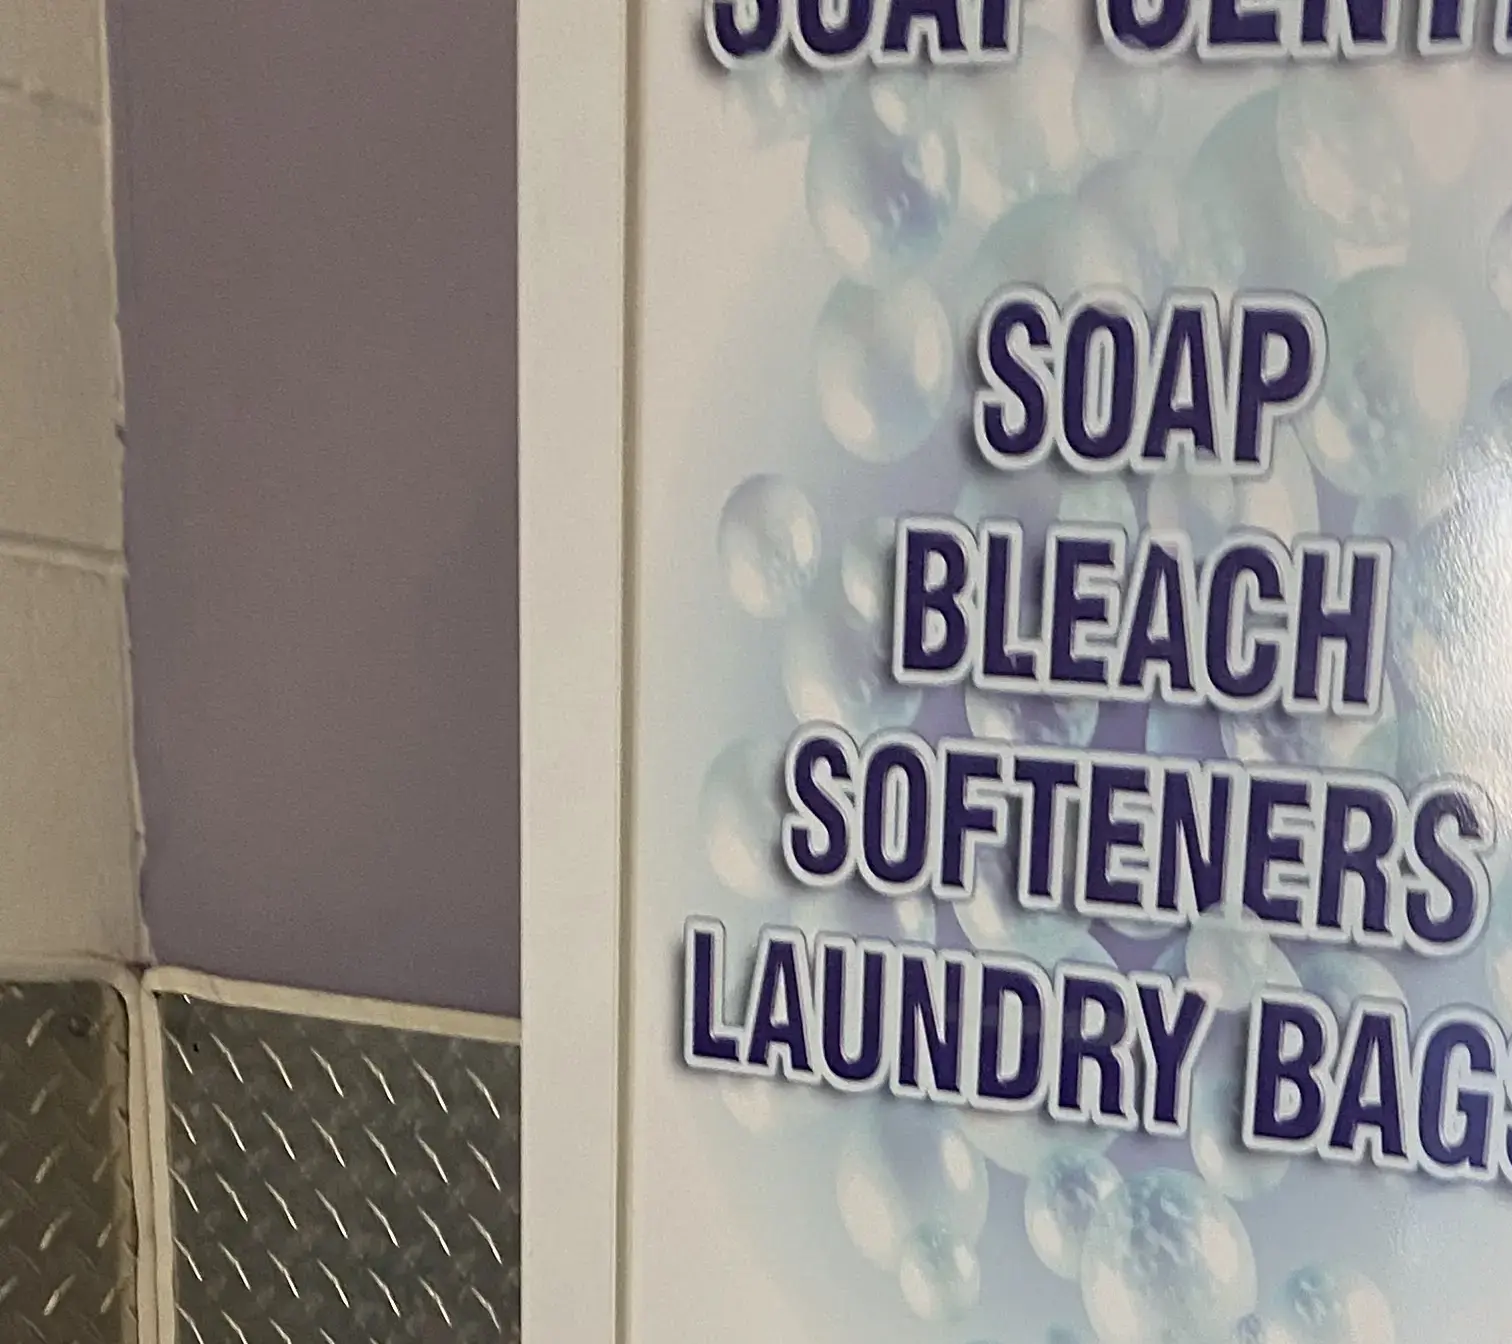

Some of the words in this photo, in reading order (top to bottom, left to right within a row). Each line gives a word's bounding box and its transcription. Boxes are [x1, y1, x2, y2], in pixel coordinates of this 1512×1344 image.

[979, 299, 1314, 463] SOAP
[901, 528, 1378, 706] BLEACH
[788, 737, 1478, 946] SOFTENERS
[690, 931, 1206, 1127] LAUNDRY
